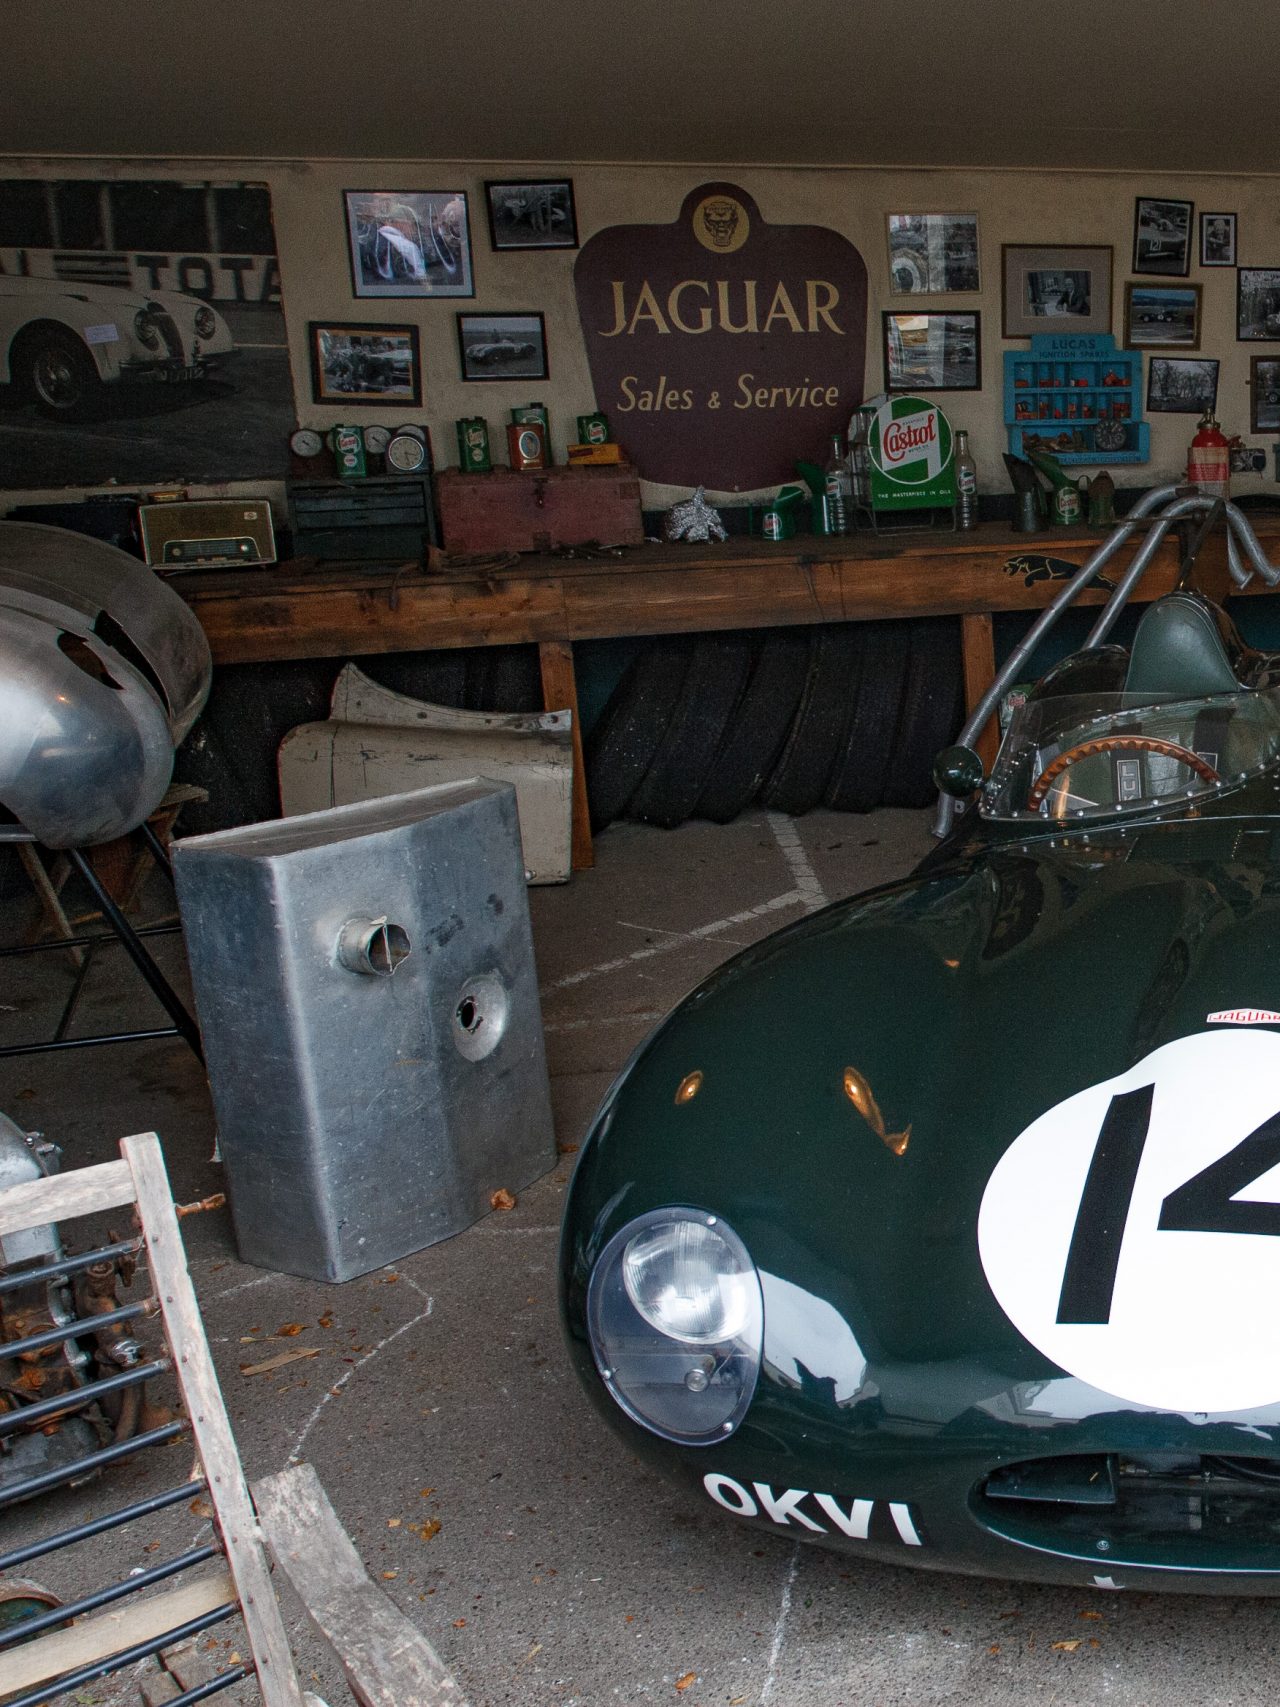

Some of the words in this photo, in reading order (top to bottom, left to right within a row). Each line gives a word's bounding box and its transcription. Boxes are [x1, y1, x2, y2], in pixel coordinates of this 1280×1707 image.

[598, 279, 847, 337] JAGUAR
[1039, 351, 1076, 359] IGNITION
[1052, 339, 1096, 350] LUCAS
[617, 375, 694, 412] Sales
[707, 391, 721, 409] &
[733, 373, 840, 409] Service
[883, 413, 937, 462] Castrol
[1213, 1011, 1280, 1021] JAGUAR
